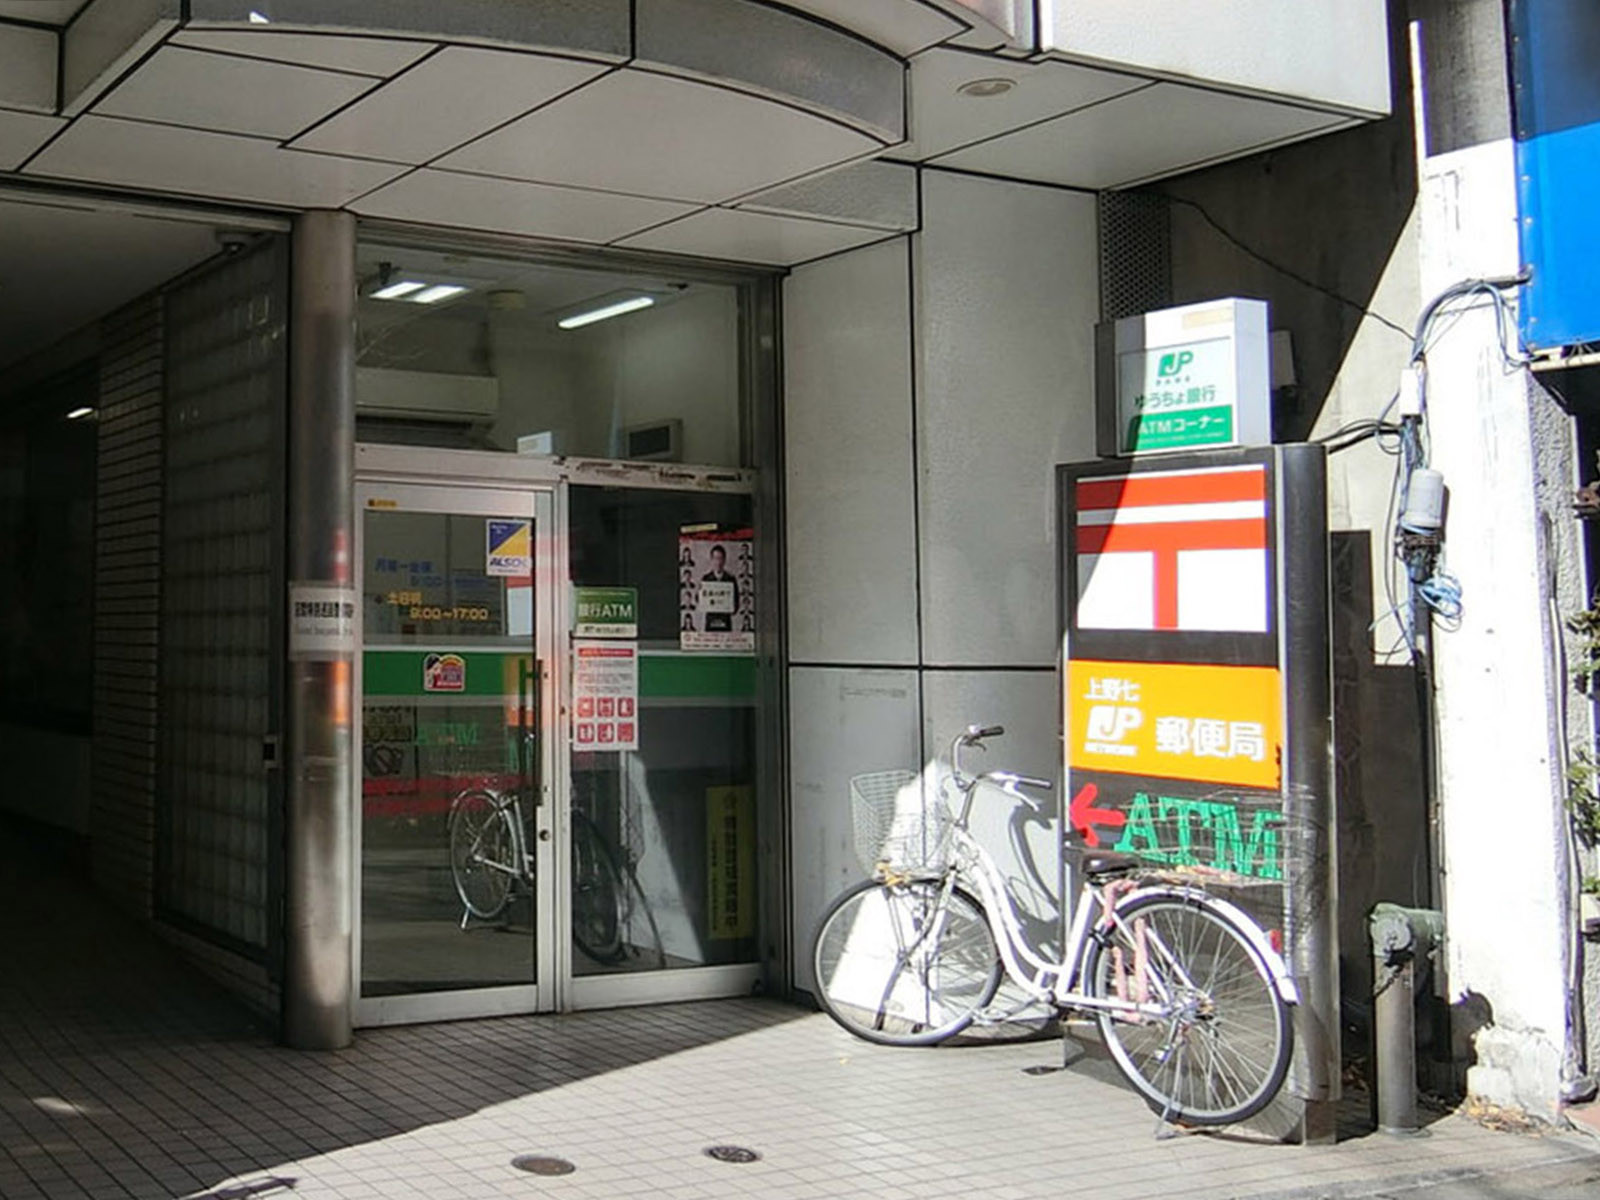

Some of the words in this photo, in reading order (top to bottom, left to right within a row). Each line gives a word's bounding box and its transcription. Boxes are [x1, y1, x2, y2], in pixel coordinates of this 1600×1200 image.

[1158, 351, 1193, 377] JP
[1134, 384, 1216, 409] ゆうちょ銀行
[1139, 414, 1225, 434] ATMコーナー
[1083, 677, 1140, 702] 上野七
[1155, 716, 1265, 761] 郵便局
[1114, 792, 1283, 881] ATM
